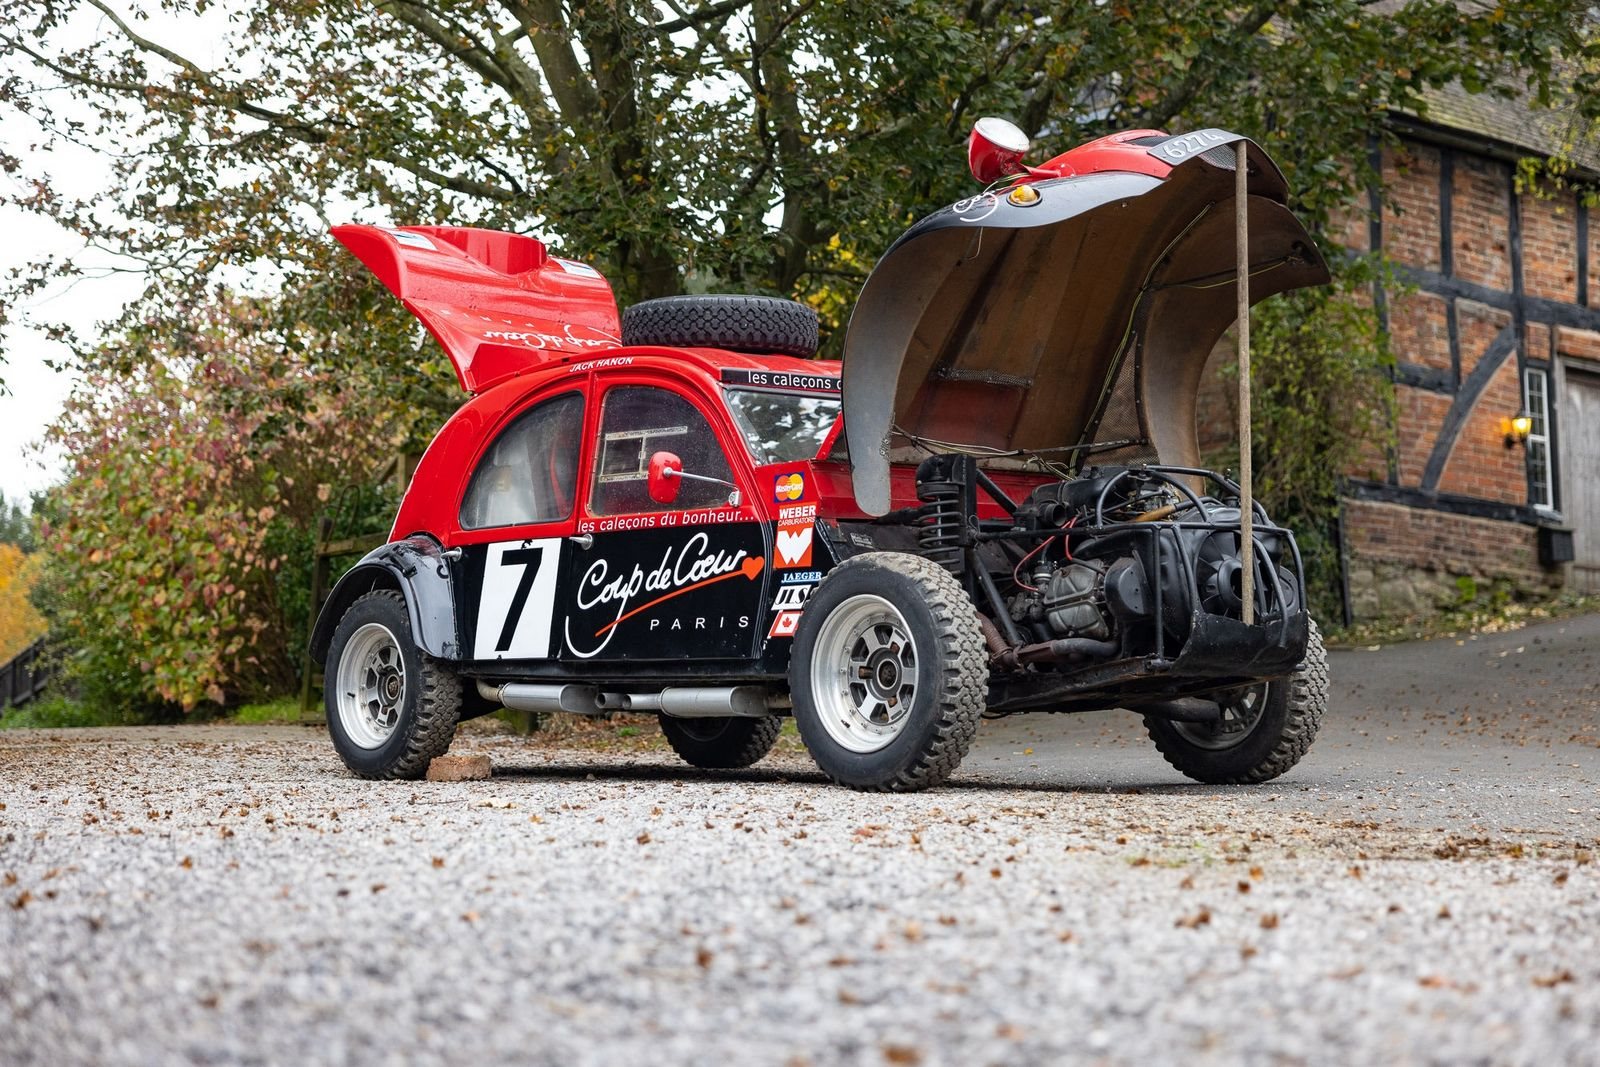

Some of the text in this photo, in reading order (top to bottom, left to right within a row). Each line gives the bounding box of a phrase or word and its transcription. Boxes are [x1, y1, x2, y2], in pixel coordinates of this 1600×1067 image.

[569, 356, 634, 373] JACK HANON
[748, 370, 768, 384] les
[773, 373, 831, 389] caleçons
[779, 505, 816, 519] WEBER
[577, 510, 754, 533] les caleçons du bonheur...
[777, 516, 816, 527] CARBURATORS
[645, 546, 673, 591] de
[781, 571, 822, 583] JAEGER
[494, 547, 544, 652] 7
[650, 616, 749, 631] PARIS
